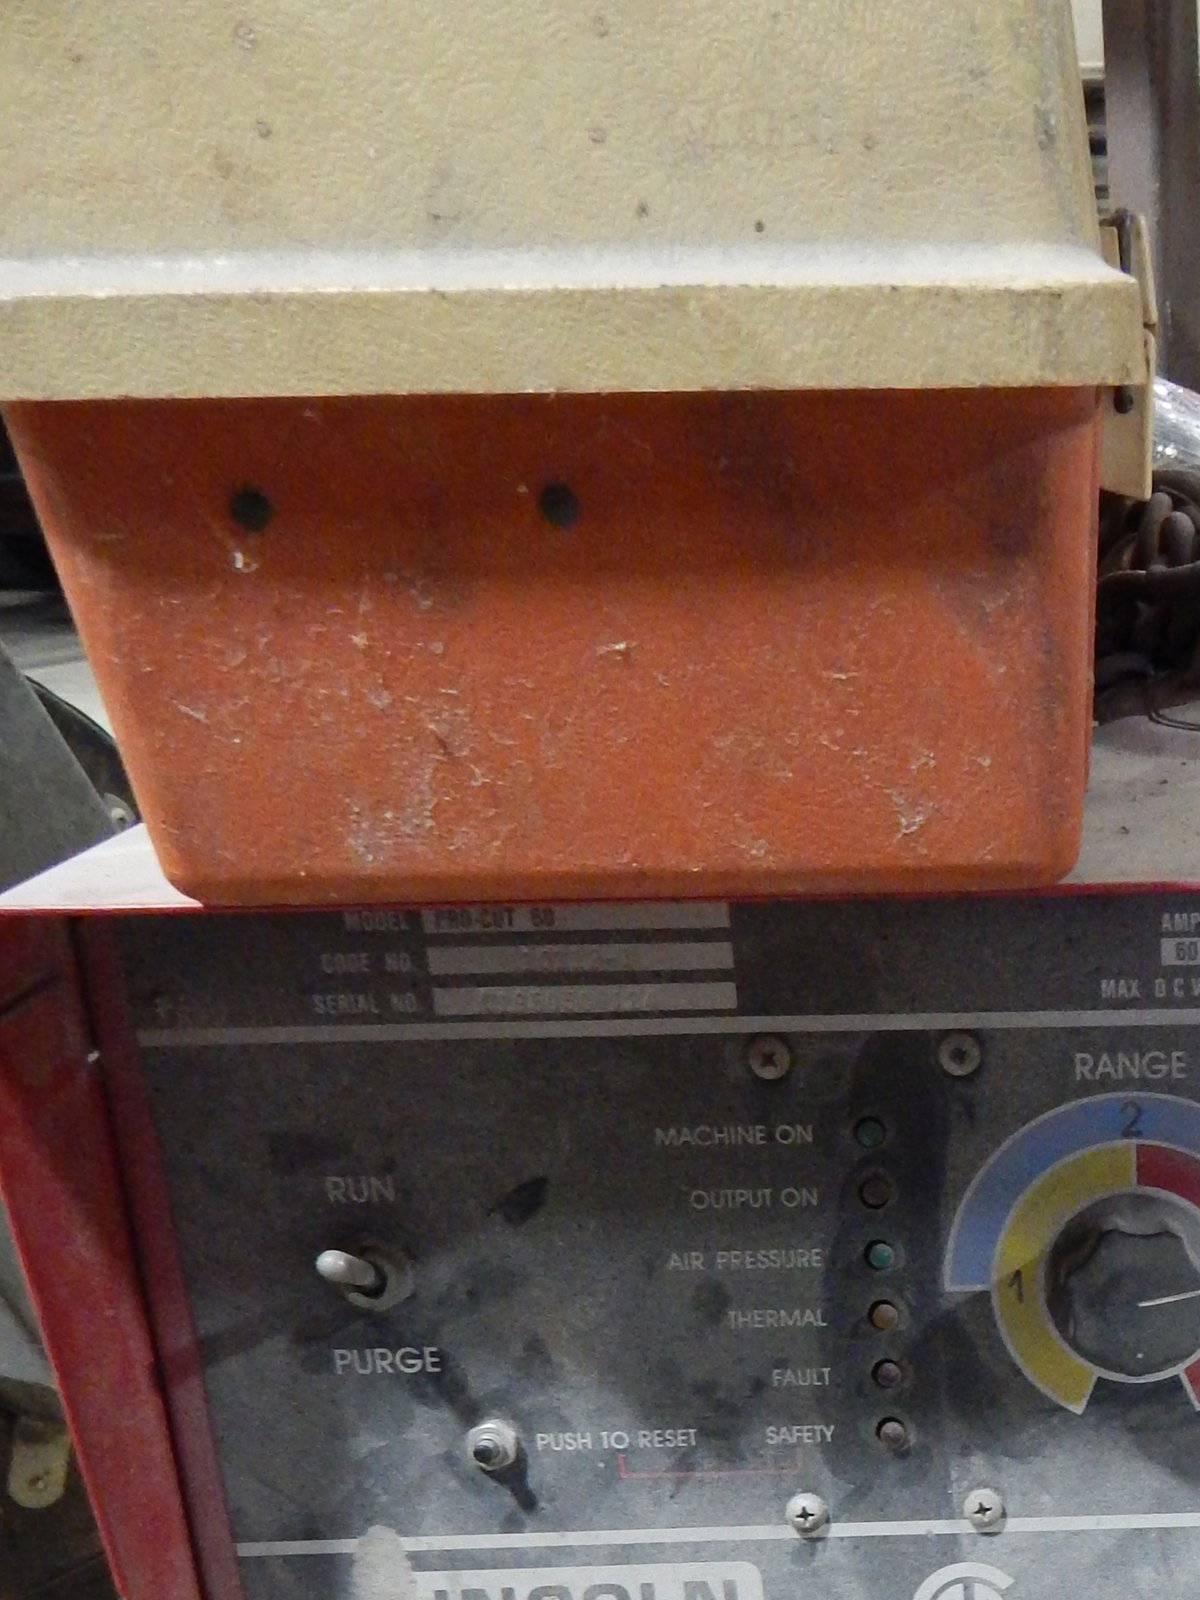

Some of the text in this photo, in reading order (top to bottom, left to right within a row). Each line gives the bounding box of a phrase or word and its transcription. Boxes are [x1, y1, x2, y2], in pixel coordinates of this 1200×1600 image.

[1174, 940, 1199, 961] 60
[321, 952, 371, 974] CODE
[1101, 978, 1141, 999] MAX
[312, 994, 379, 1014] SERIAL
[1073, 1050, 1188, 1081] RANGE
[1120, 1101, 1143, 1138] 2
[654, 1123, 814, 1147] MACHINE ON
[325, 1175, 397, 1203] RUN
[689, 1187, 819, 1211] OUTPUT ON
[668, 1247, 824, 1271] AIR PRESSURE
[1008, 1269, 1025, 1303] 1
[727, 1308, 829, 1330] THERMAL
[333, 1347, 443, 1376] PURGE
[771, 1366, 831, 1388] FAULT
[535, 1428, 698, 1452] PUSH TO RESET
[765, 1425, 836, 1447] SAFETY
